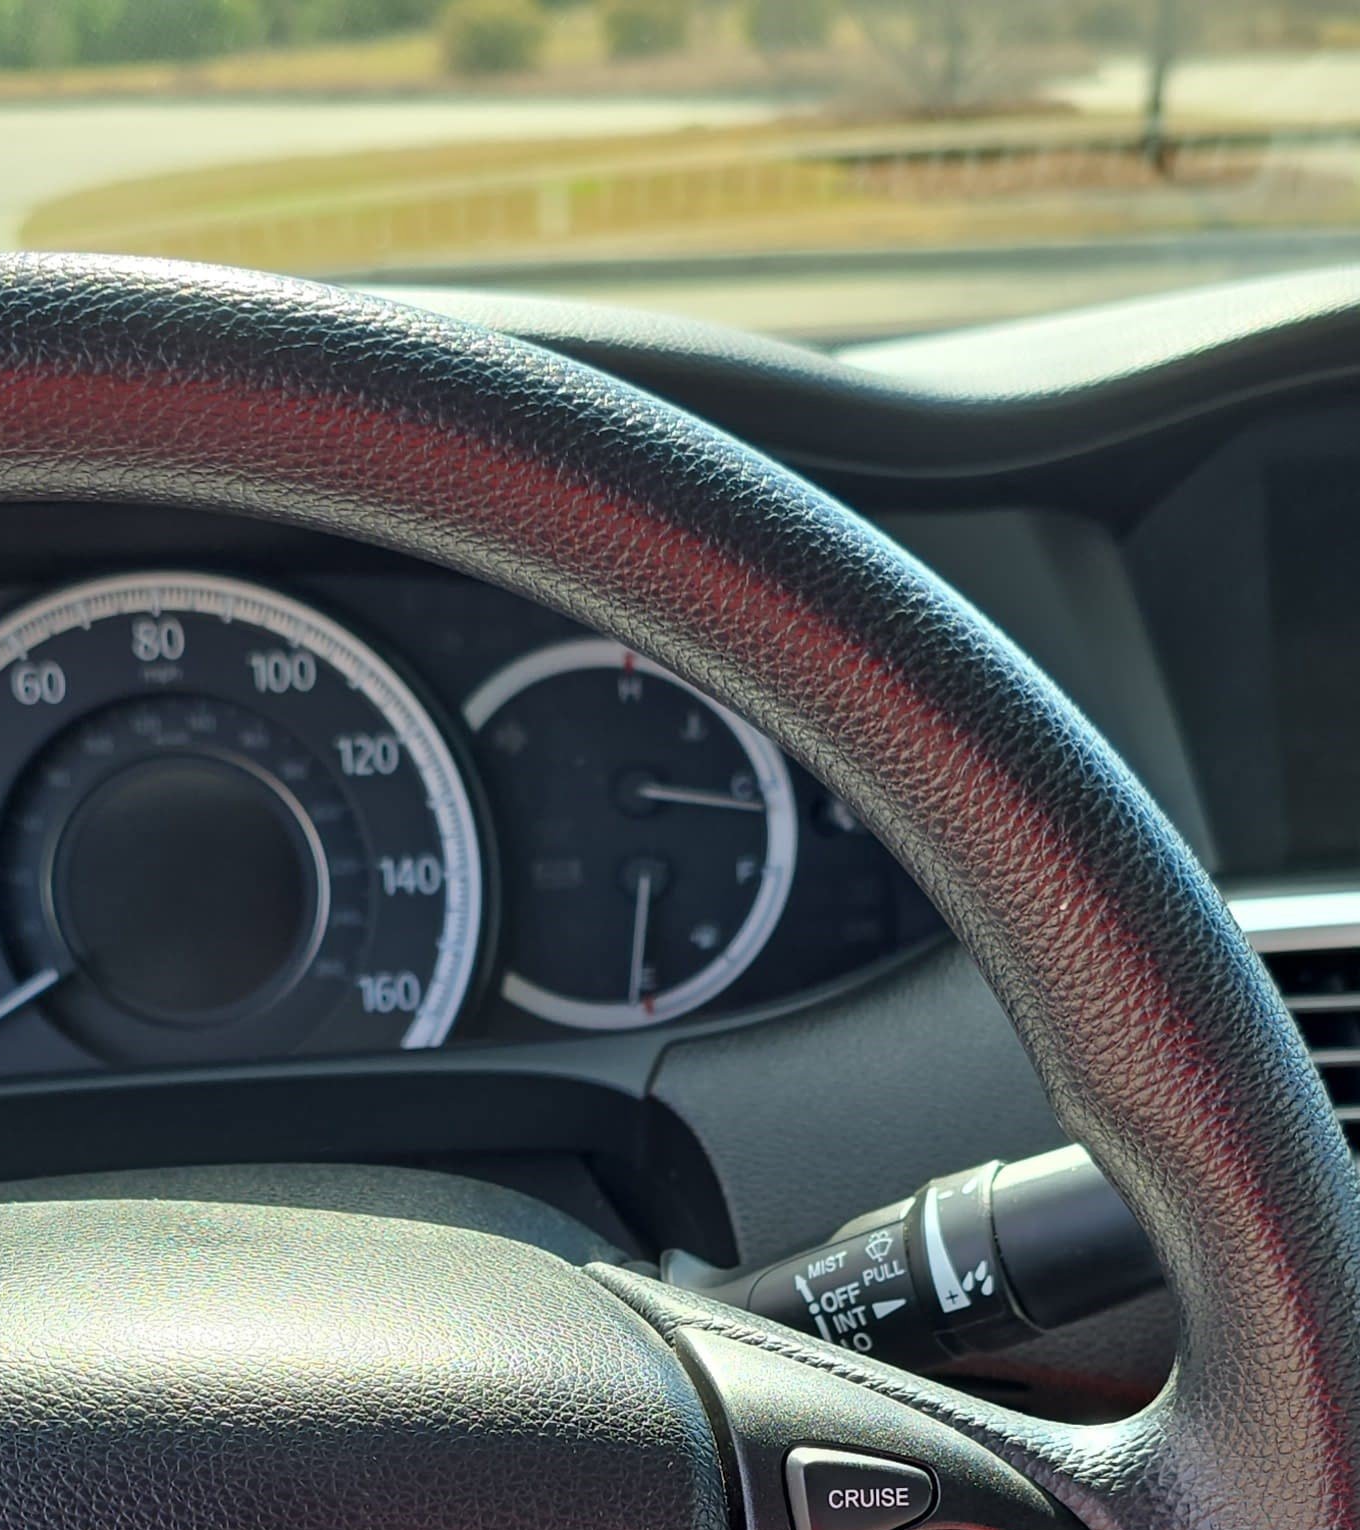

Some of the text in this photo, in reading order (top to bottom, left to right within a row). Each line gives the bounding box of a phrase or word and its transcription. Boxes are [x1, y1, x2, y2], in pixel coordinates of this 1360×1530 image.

[132, 619, 185, 661] 80
[10, 660, 67, 705] 60
[250, 651, 317, 693] 100
[337, 733, 399, 776] 120
[379, 855, 440, 896] 140
[359, 974, 421, 1013] 160
[807, 1251, 848, 1279] MIST
[862, 1260, 905, 1287] PULL
[820, 1282, 861, 1313] OFF
[832, 1305, 867, 1335] INT
[841, 1332, 873, 1352] O
[828, 1487, 909, 1509] CRUISE
